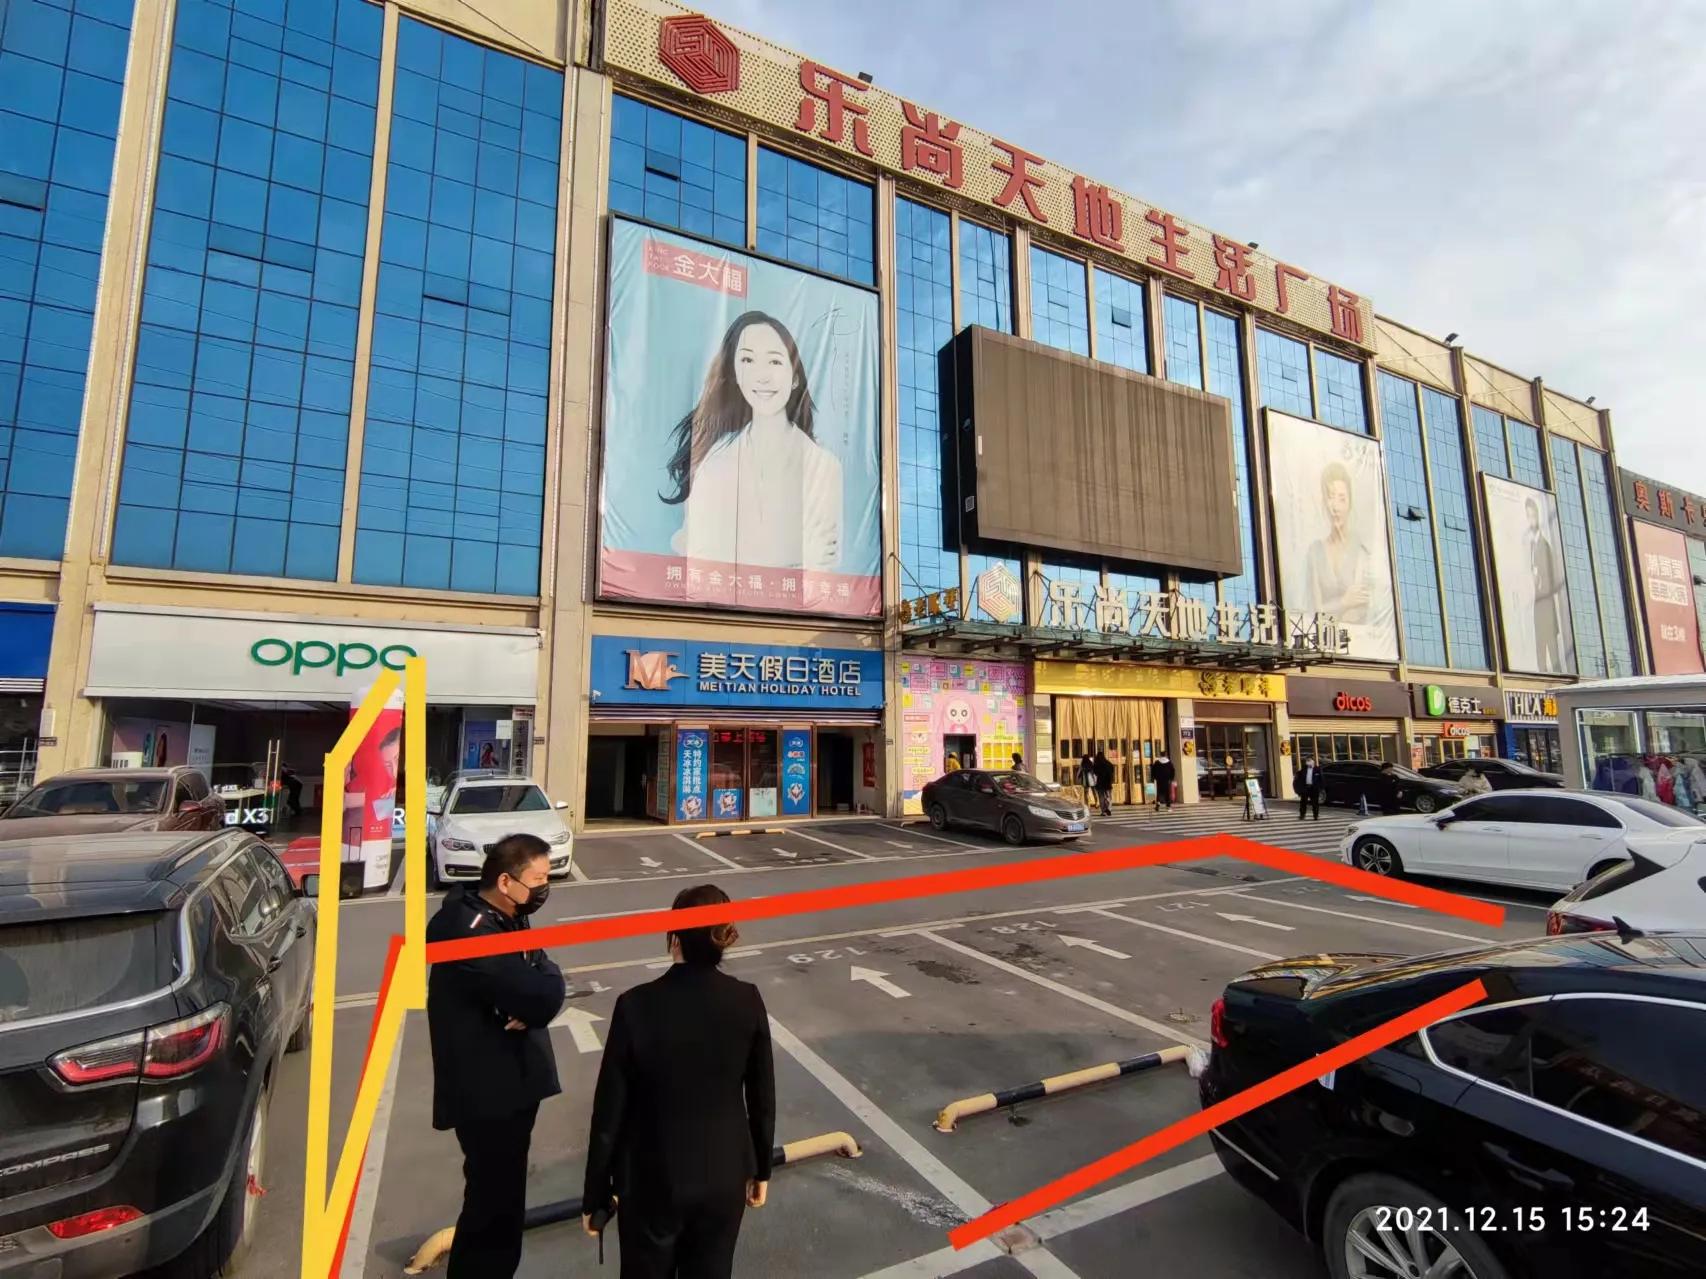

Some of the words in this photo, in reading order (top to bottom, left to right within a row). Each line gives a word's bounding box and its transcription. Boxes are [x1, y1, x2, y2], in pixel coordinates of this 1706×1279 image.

[793, 60, 1363, 343] 乐尚天地生活广场
[672, 254, 742, 293] 金大福
[1633, 479, 1706, 528] 奥斯卡
[700, 652, 861, 684] 美天假日酒店
[760, 683, 816, 694] HOLIDAY
[821, 686, 861, 697] HOTEL
[1335, 691, 1372, 712] dicos
[1448, 697, 1483, 715] 德克士
[1514, 696, 1542, 716] HLA
[1449, 725, 1471, 737] dicos
[786, 945, 869, 965] 129
